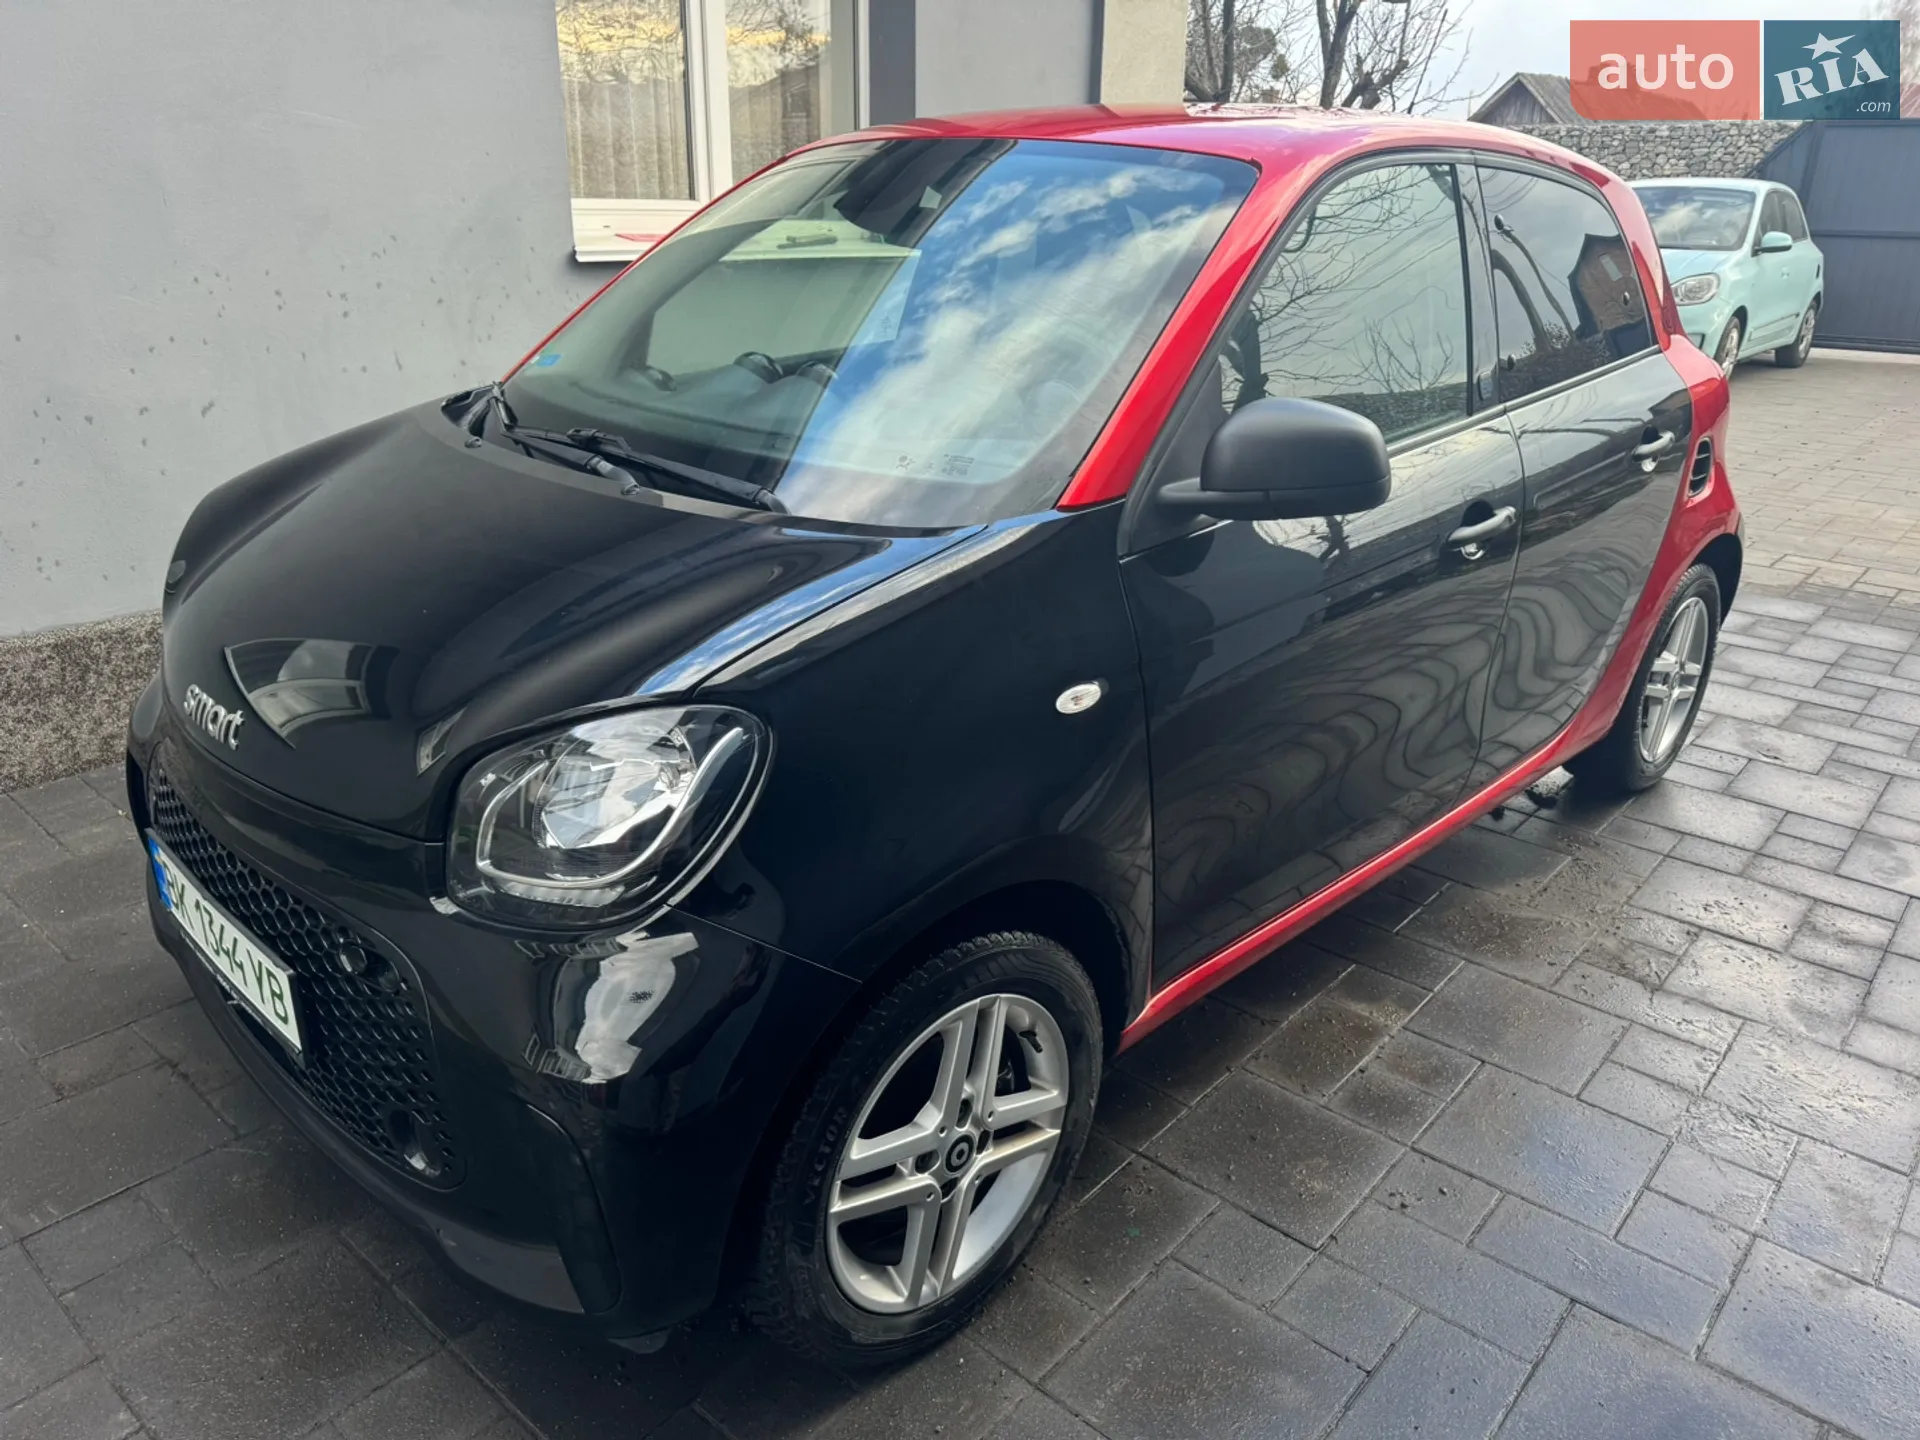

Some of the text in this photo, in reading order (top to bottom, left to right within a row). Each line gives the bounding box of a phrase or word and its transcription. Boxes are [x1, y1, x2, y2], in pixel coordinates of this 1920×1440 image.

[184, 684, 245, 751] smart
[195, 898, 248, 988] 1344
[248, 947, 289, 1026] YB
[803, 1106, 849, 1206] VECTOR
